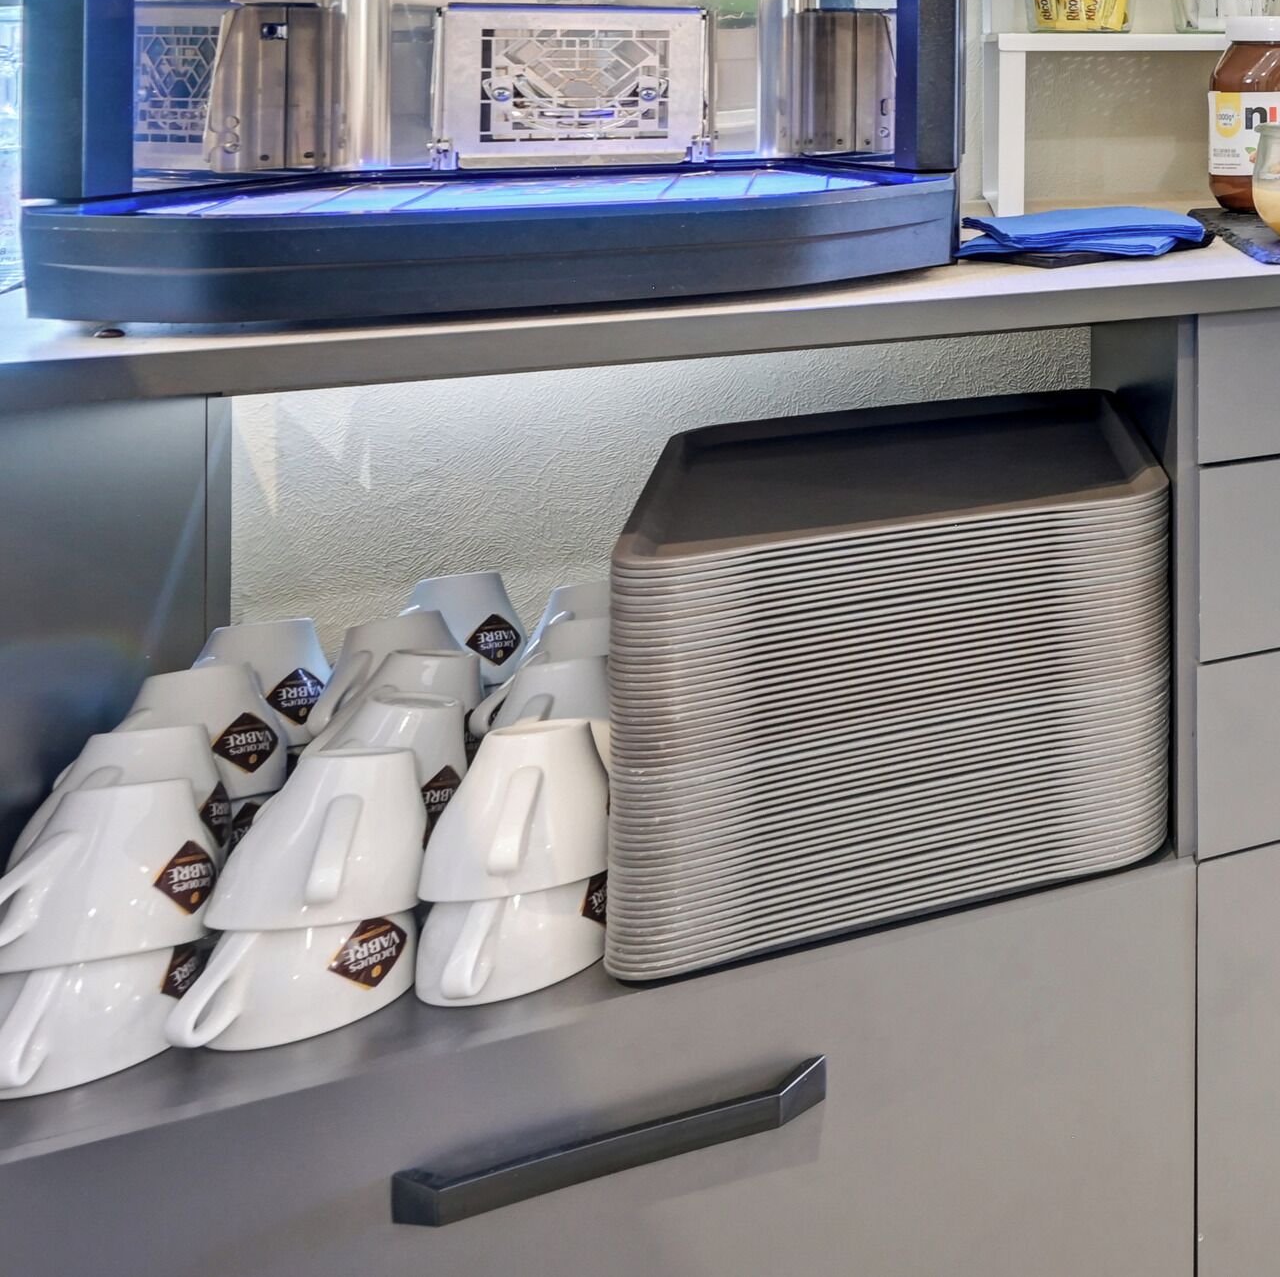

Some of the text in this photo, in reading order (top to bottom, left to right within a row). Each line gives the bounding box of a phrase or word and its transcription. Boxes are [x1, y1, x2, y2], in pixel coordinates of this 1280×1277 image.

[476, 629, 517, 644] VABRE
[480, 639, 514, 650] Jacques
[223, 730, 273, 749] VABRE
[228, 742, 270, 756] Jacques
[342, 930, 400, 966] VABRE
[348, 944, 397, 973] Jacques
